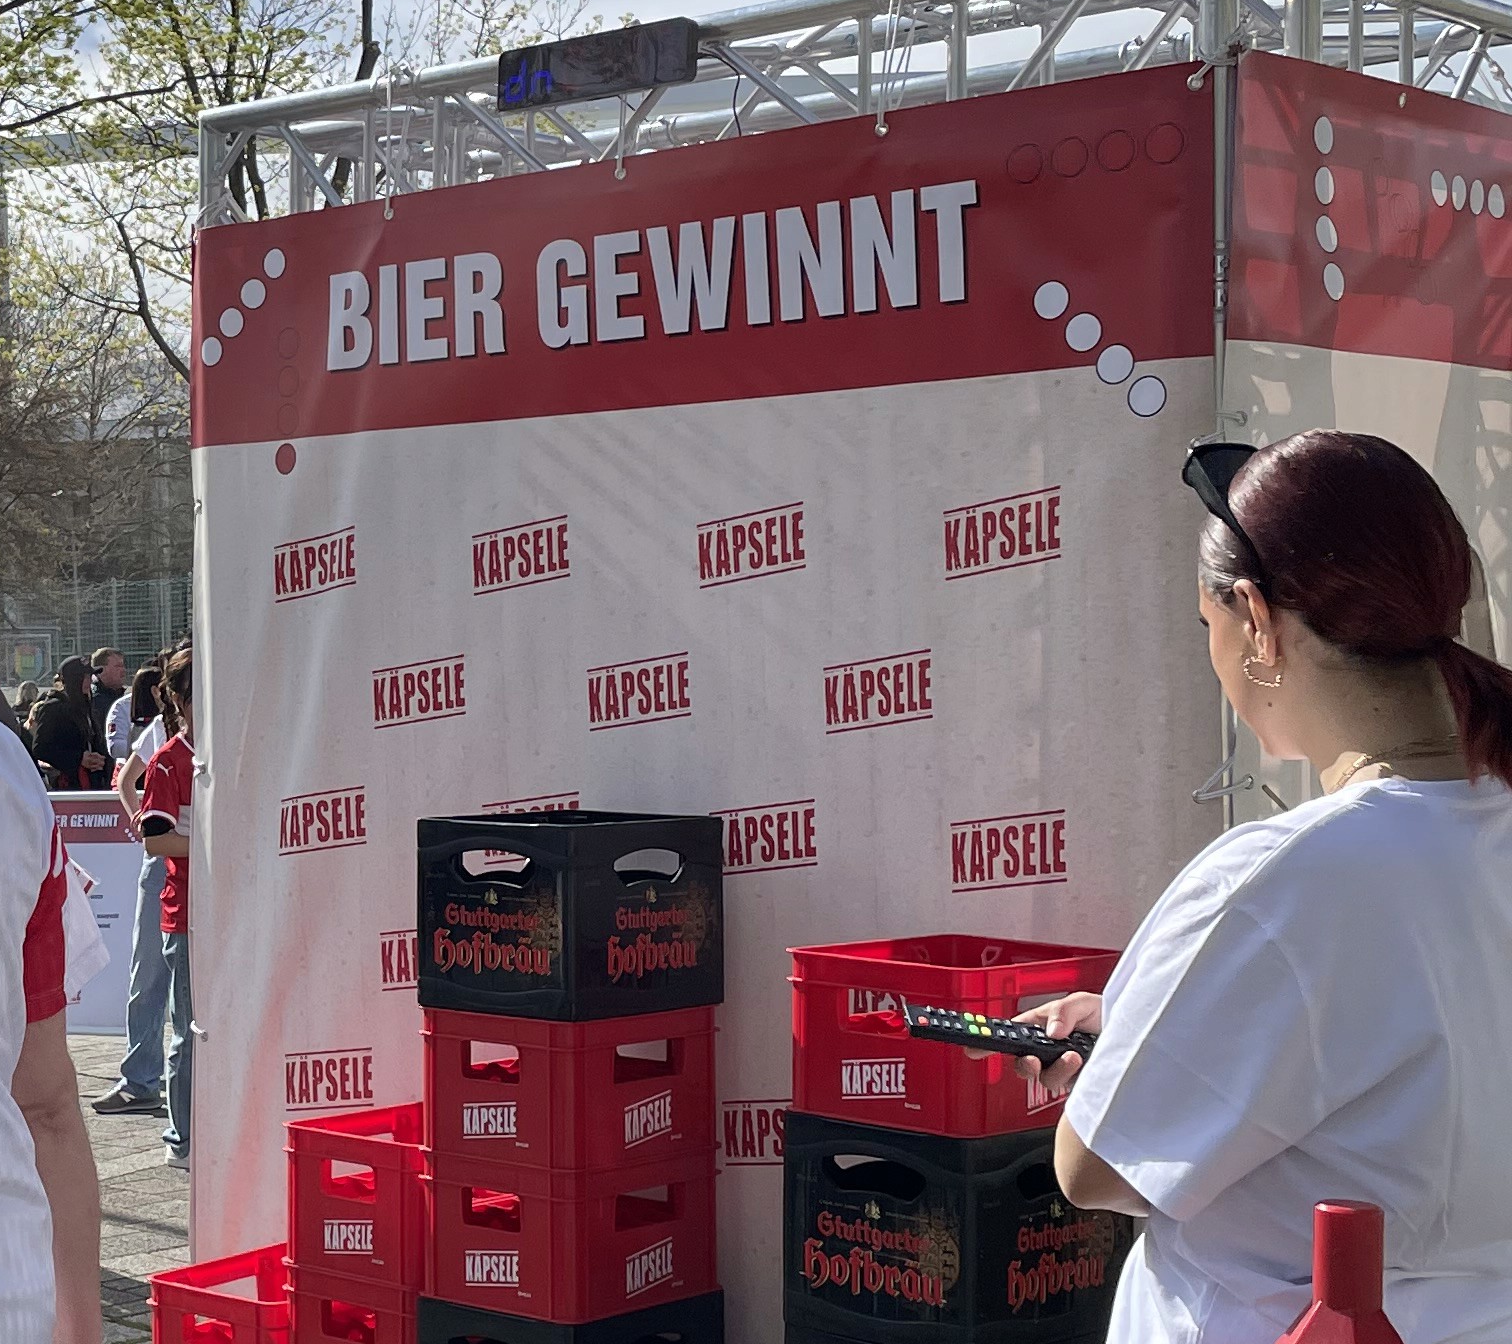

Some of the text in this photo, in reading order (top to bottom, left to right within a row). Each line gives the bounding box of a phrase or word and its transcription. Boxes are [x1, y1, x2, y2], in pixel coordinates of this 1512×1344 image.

[327, 179, 978, 371] BIER GEWINNT
[472, 523, 570, 588] KÄPSELE
[698, 511, 805, 581] KÄPSELE
[944, 496, 1061, 571] KÄPSELE
[274, 534, 356, 596] KÄPSELE
[373, 663, 466, 722] KÄPSELE
[588, 661, 691, 723] KÄPSELE
[825, 658, 932, 725] KÄPSELE
[70, 814, 120, 828] GEWINNT
[280, 794, 367, 849] KÄPSELE
[951, 820, 1066, 884] KÄPSELE
[433, 928, 552, 977] Hofbräu
[607, 932, 698, 984] Hofbräu
[285, 1055, 373, 1104] KÄPSELE
[842, 1060, 906, 1094] KÄPSELE
[463, 1103, 517, 1135] KÄPSELE
[624, 1095, 672, 1144] KÄPSELE
[723, 1103, 786, 1158] KÄPS
[323, 1221, 373, 1251] KÄPSELE
[817, 1210, 932, 1254] Stuttgarter
[465, 1253, 519, 1284] KÄPSELE
[626, 1244, 673, 1294] KÄPSELE
[804, 1237, 946, 1308] Hofbräu
[1007, 1248, 1105, 1314] Hofbräu
